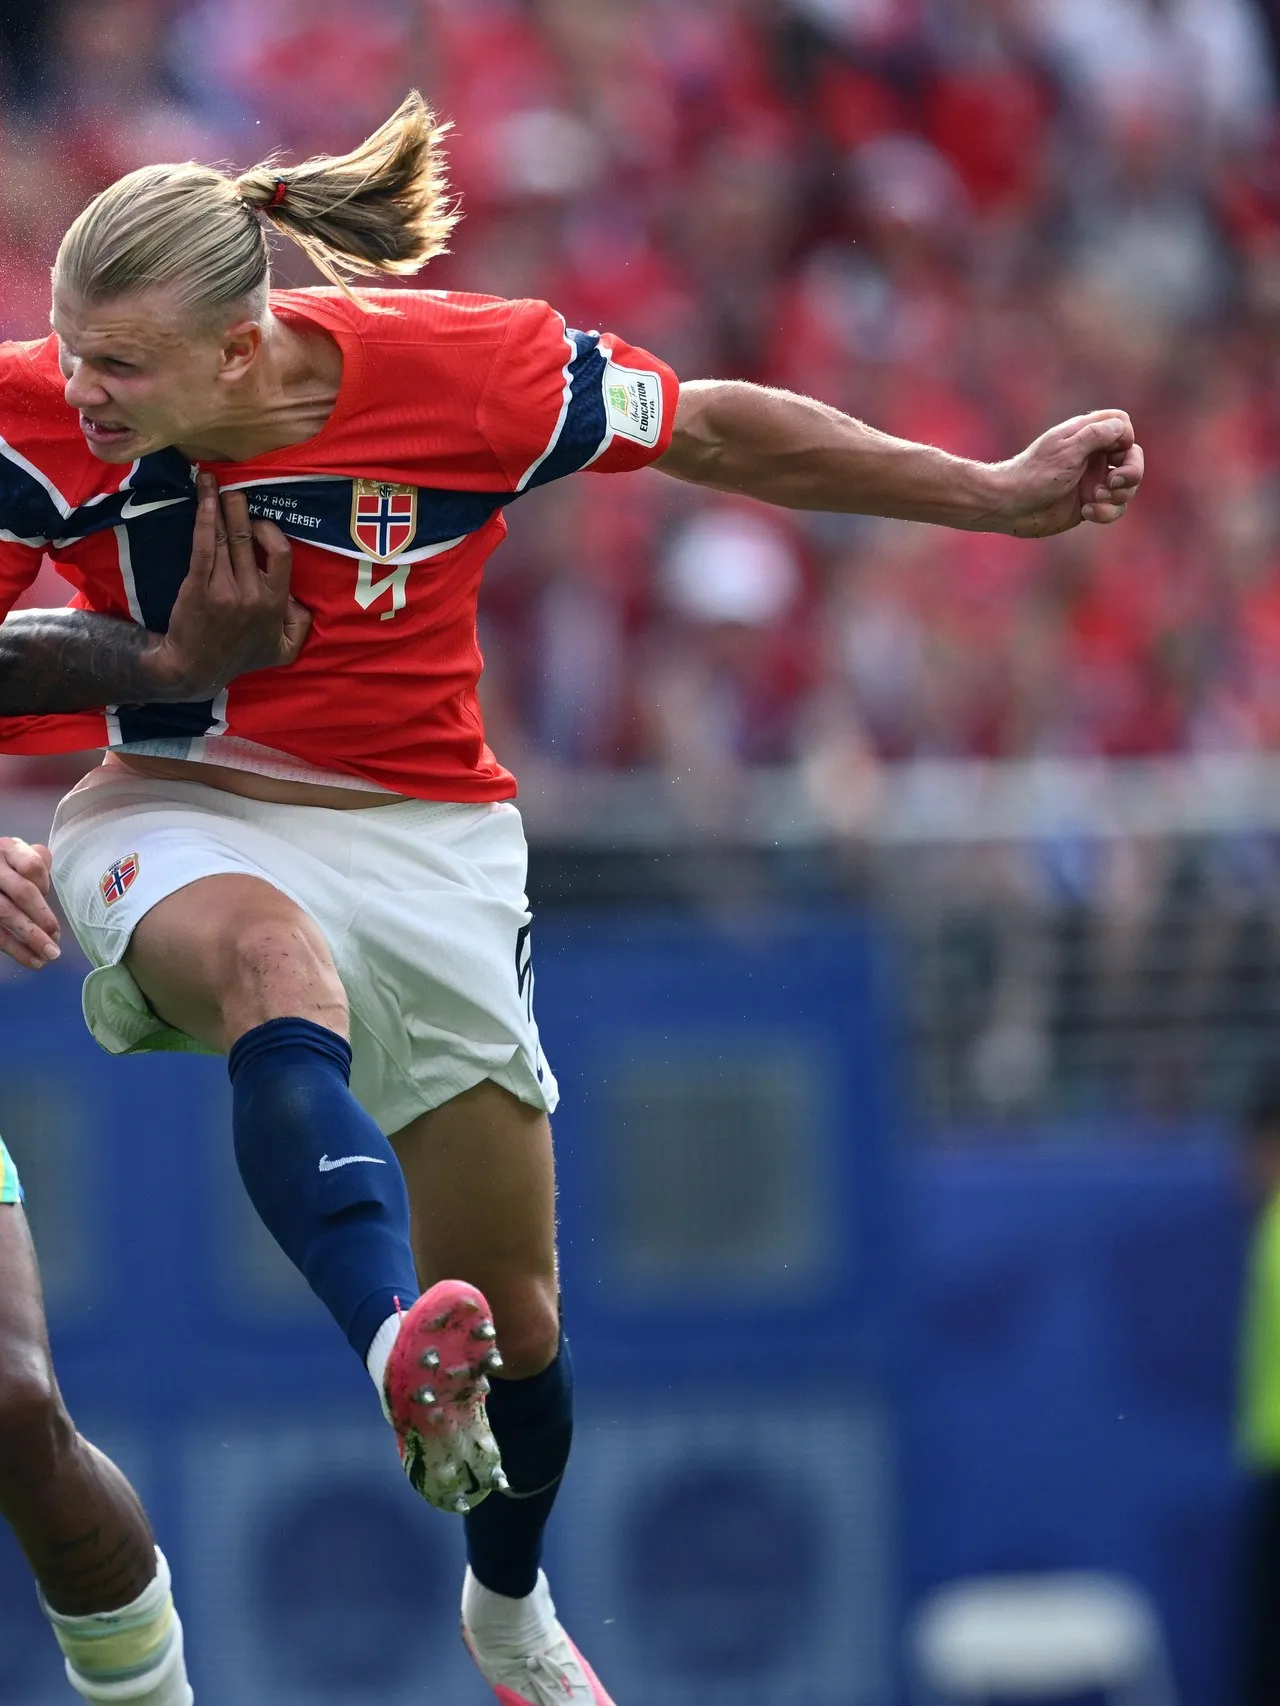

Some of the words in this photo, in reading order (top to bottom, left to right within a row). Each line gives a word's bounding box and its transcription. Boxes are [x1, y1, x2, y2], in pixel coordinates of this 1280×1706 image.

[637, 381, 649, 433] EDUCATION
[262, 507, 284, 521] NEW
[285, 512, 322, 529] JERSEY
